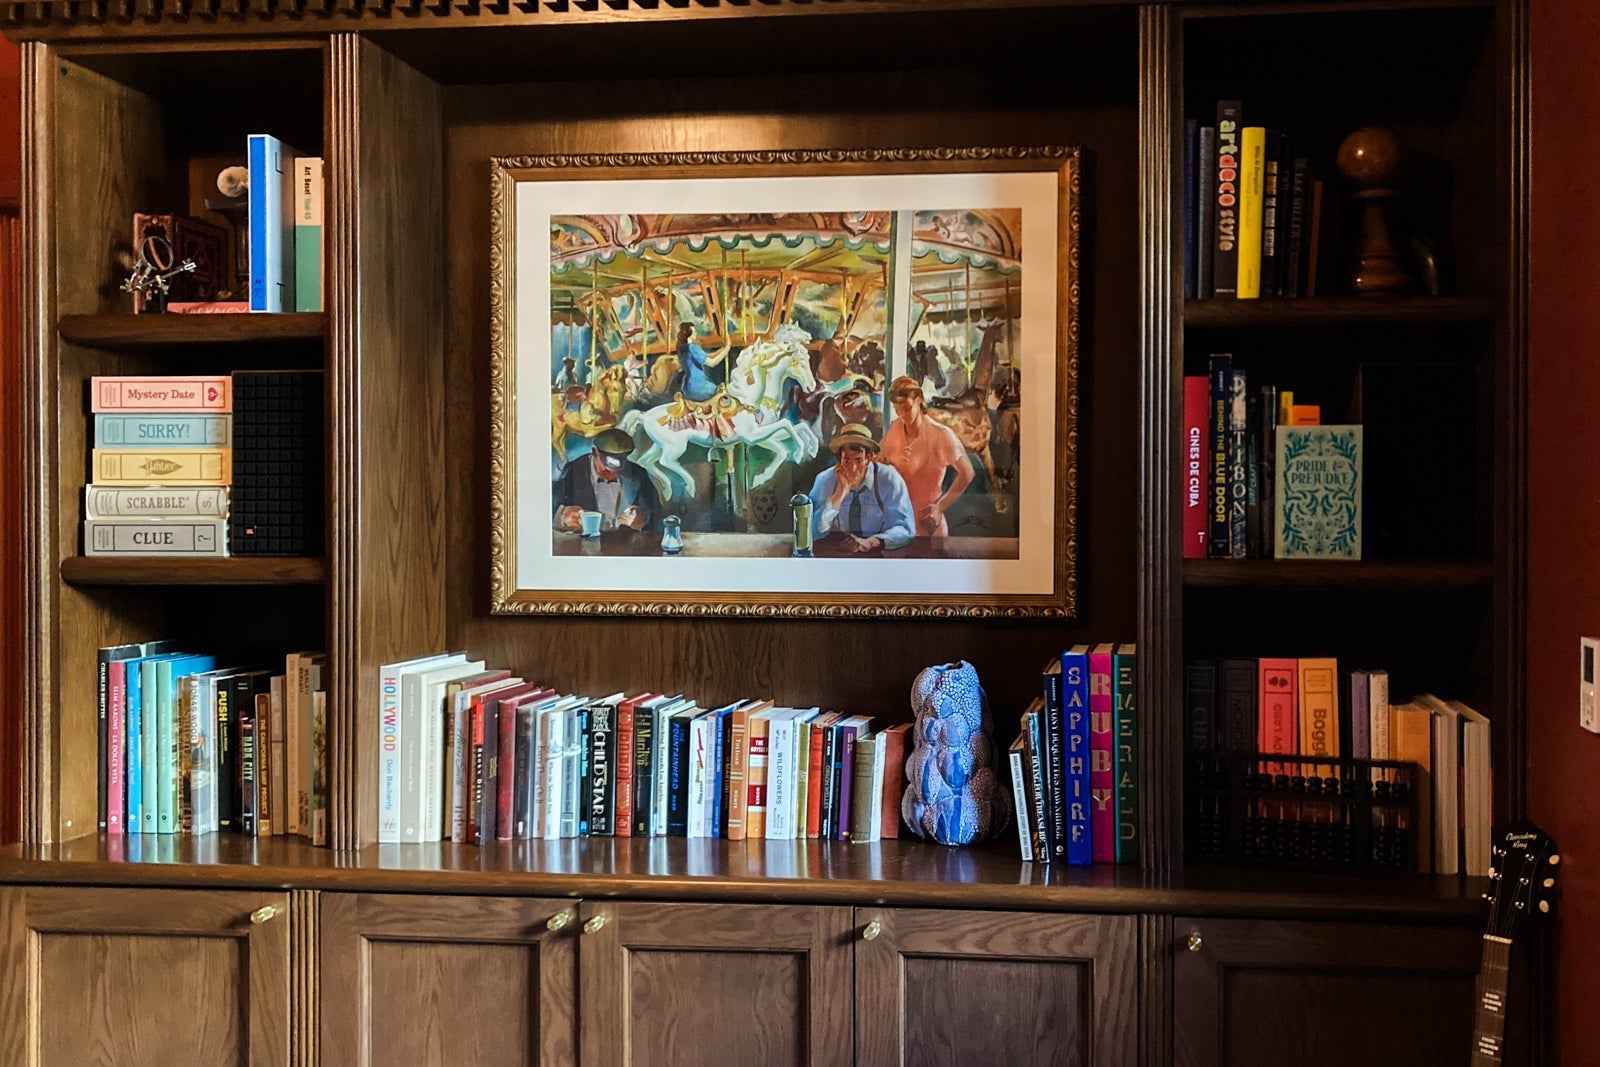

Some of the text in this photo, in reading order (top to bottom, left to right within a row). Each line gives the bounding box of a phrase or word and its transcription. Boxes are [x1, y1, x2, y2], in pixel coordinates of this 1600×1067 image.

[1219, 120, 1238, 154] art
[1218, 210, 1236, 251] style
[127, 389, 168, 400] Mystery
[171, 389, 195, 399] Date
[138, 424, 190, 438] SORRY!
[1216, 400, 1225, 432] BEHIND
[1216, 434, 1225, 450] THE
[1189, 427, 1200, 507] CINES DE CUBA
[1215, 453, 1225, 484] BLUE
[1296, 460, 1326, 471] PRIDE
[126, 497, 186, 509] SCRABBLE
[1215, 487, 1225, 523] DOOR
[133, 532, 173, 544] CLUE
[190, 684, 198, 741] JONAS WOOD
[218, 691, 228, 721] PUSH
[384, 677, 396, 752] HOLLYWOOD
[1051, 707, 1059, 730] TONY
[111, 735, 118, 743] LA
[636, 729, 651, 765] Marilyn
[1089, 673, 1111, 810] RUBY
[1312, 708, 1329, 757] Boggl
[243, 736, 253, 781] DARK CITY
[1031, 756, 1039, 782] DIVING
[1050, 733, 1061, 786] DUQUETTE'S
[1068, 666, 1086, 842] SAPPHIRE
[1117, 668, 1135, 840] EMERALD
[456, 760, 465, 787] Smith
[536, 766, 545, 784] Thing
[593, 731, 605, 815] CHILD STAR
[385, 775, 394, 811] Bachardy
[536, 786, 543, 797] On
[1033, 782, 1041, 800] FOR
[1035, 800, 1046, 842] TREASURE
[1053, 787, 1064, 840] DAWNRIDGE
